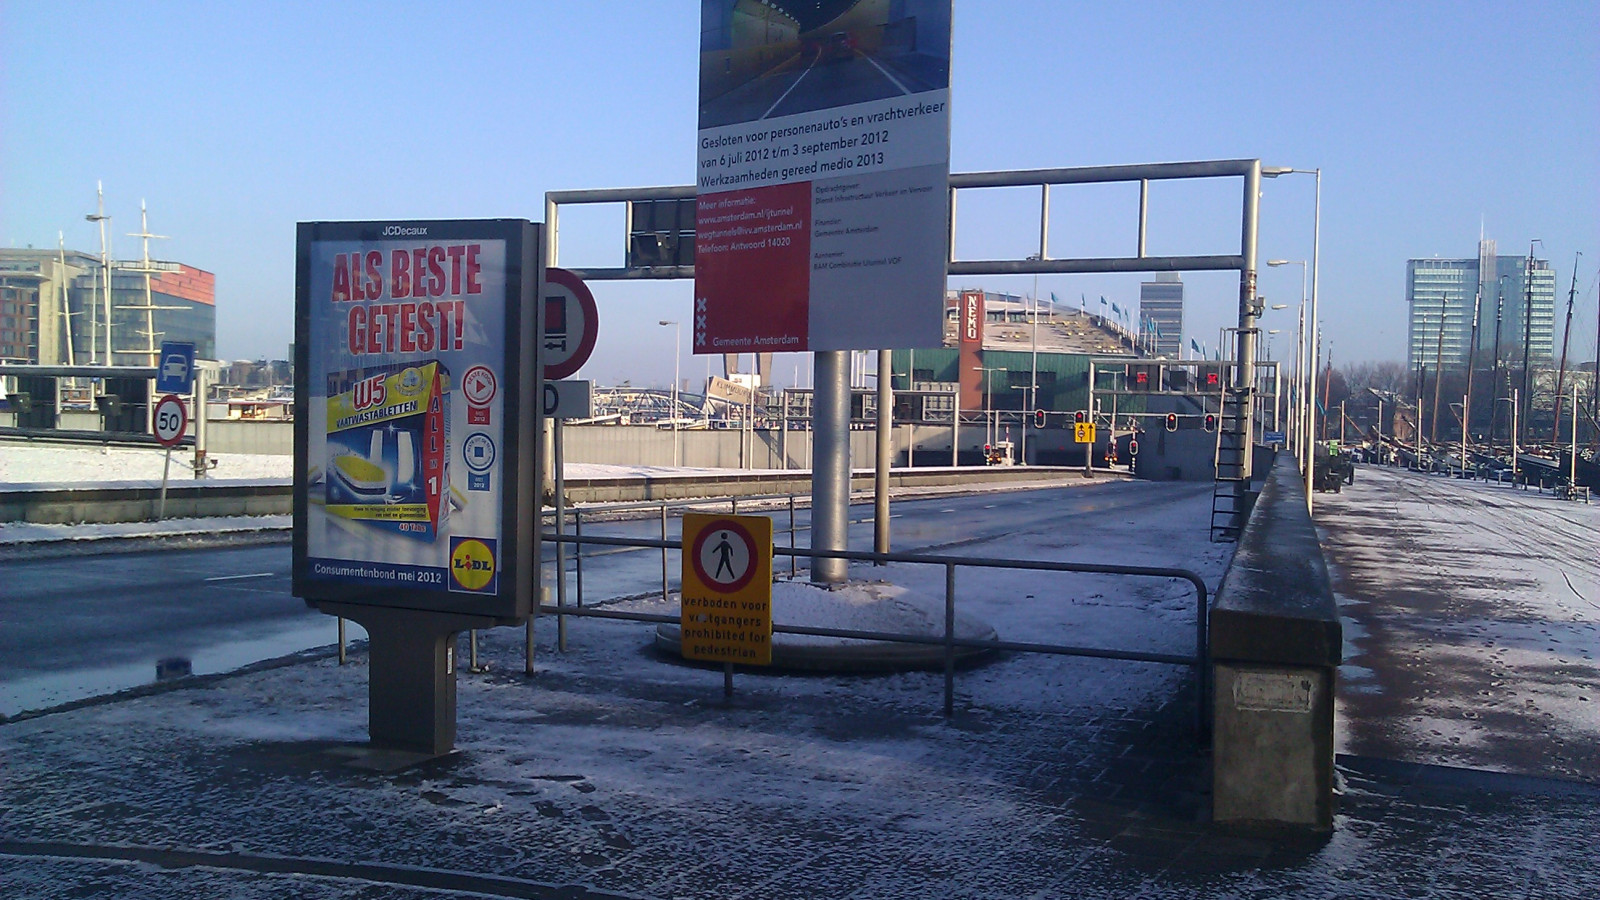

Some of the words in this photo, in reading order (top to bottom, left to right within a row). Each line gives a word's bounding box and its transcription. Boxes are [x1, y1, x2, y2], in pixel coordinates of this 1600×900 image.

[701, 132, 743, 149] Gesloten
[745, 131, 768, 143] voor
[851, 116, 864, 126] en
[867, 102, 945, 123] vrachtverkeer
[701, 158, 717, 168] van
[720, 154, 726, 166] 6
[728, 153, 742, 168] juli
[745, 148, 769, 163] 2012
[772, 146, 790, 159] t/m
[792, 144, 799, 155] 3
[801, 137, 858, 155] september
[861, 130, 889, 145] 2012
[701, 168, 779, 187] Werkzaamheden
[781, 161, 817, 180] gereed
[820, 157, 853, 172] medio
[856, 152, 884, 167] 2013
[698, 201, 717, 210] Meer
[718, 196, 756, 208] informatie:
[382, 225, 428, 236] JCDecaux
[730, 240, 766, 251] Antwoord
[767, 237, 791, 248] 14020
[332, 250, 382, 302] ALS
[391, 244, 482, 299] BESTE
[967, 295, 977, 339] NEMO
[348, 300, 465, 355] GETEST!
[713, 336, 752, 347] Gemeente
[754, 333, 799, 345] Amsterdam
[353, 372, 387, 412] W5
[158, 412, 179, 431] 50
[336, 400, 418, 428] VAATWASTABLETTEN
[428, 476, 437, 495] 1
[399, 523, 409, 531] 40
[314, 562, 396, 580] Consumentenbond
[397, 571, 416, 582] mei
[417, 571, 442, 584] 2012
[684, 596, 737, 610] verboden
[741, 600, 767, 611] voor
[688, 611, 761, 629] vtgangers
[684, 628, 745, 642] prohibited
[749, 632, 767, 643] for
[694, 645, 757, 658] pedestrian
